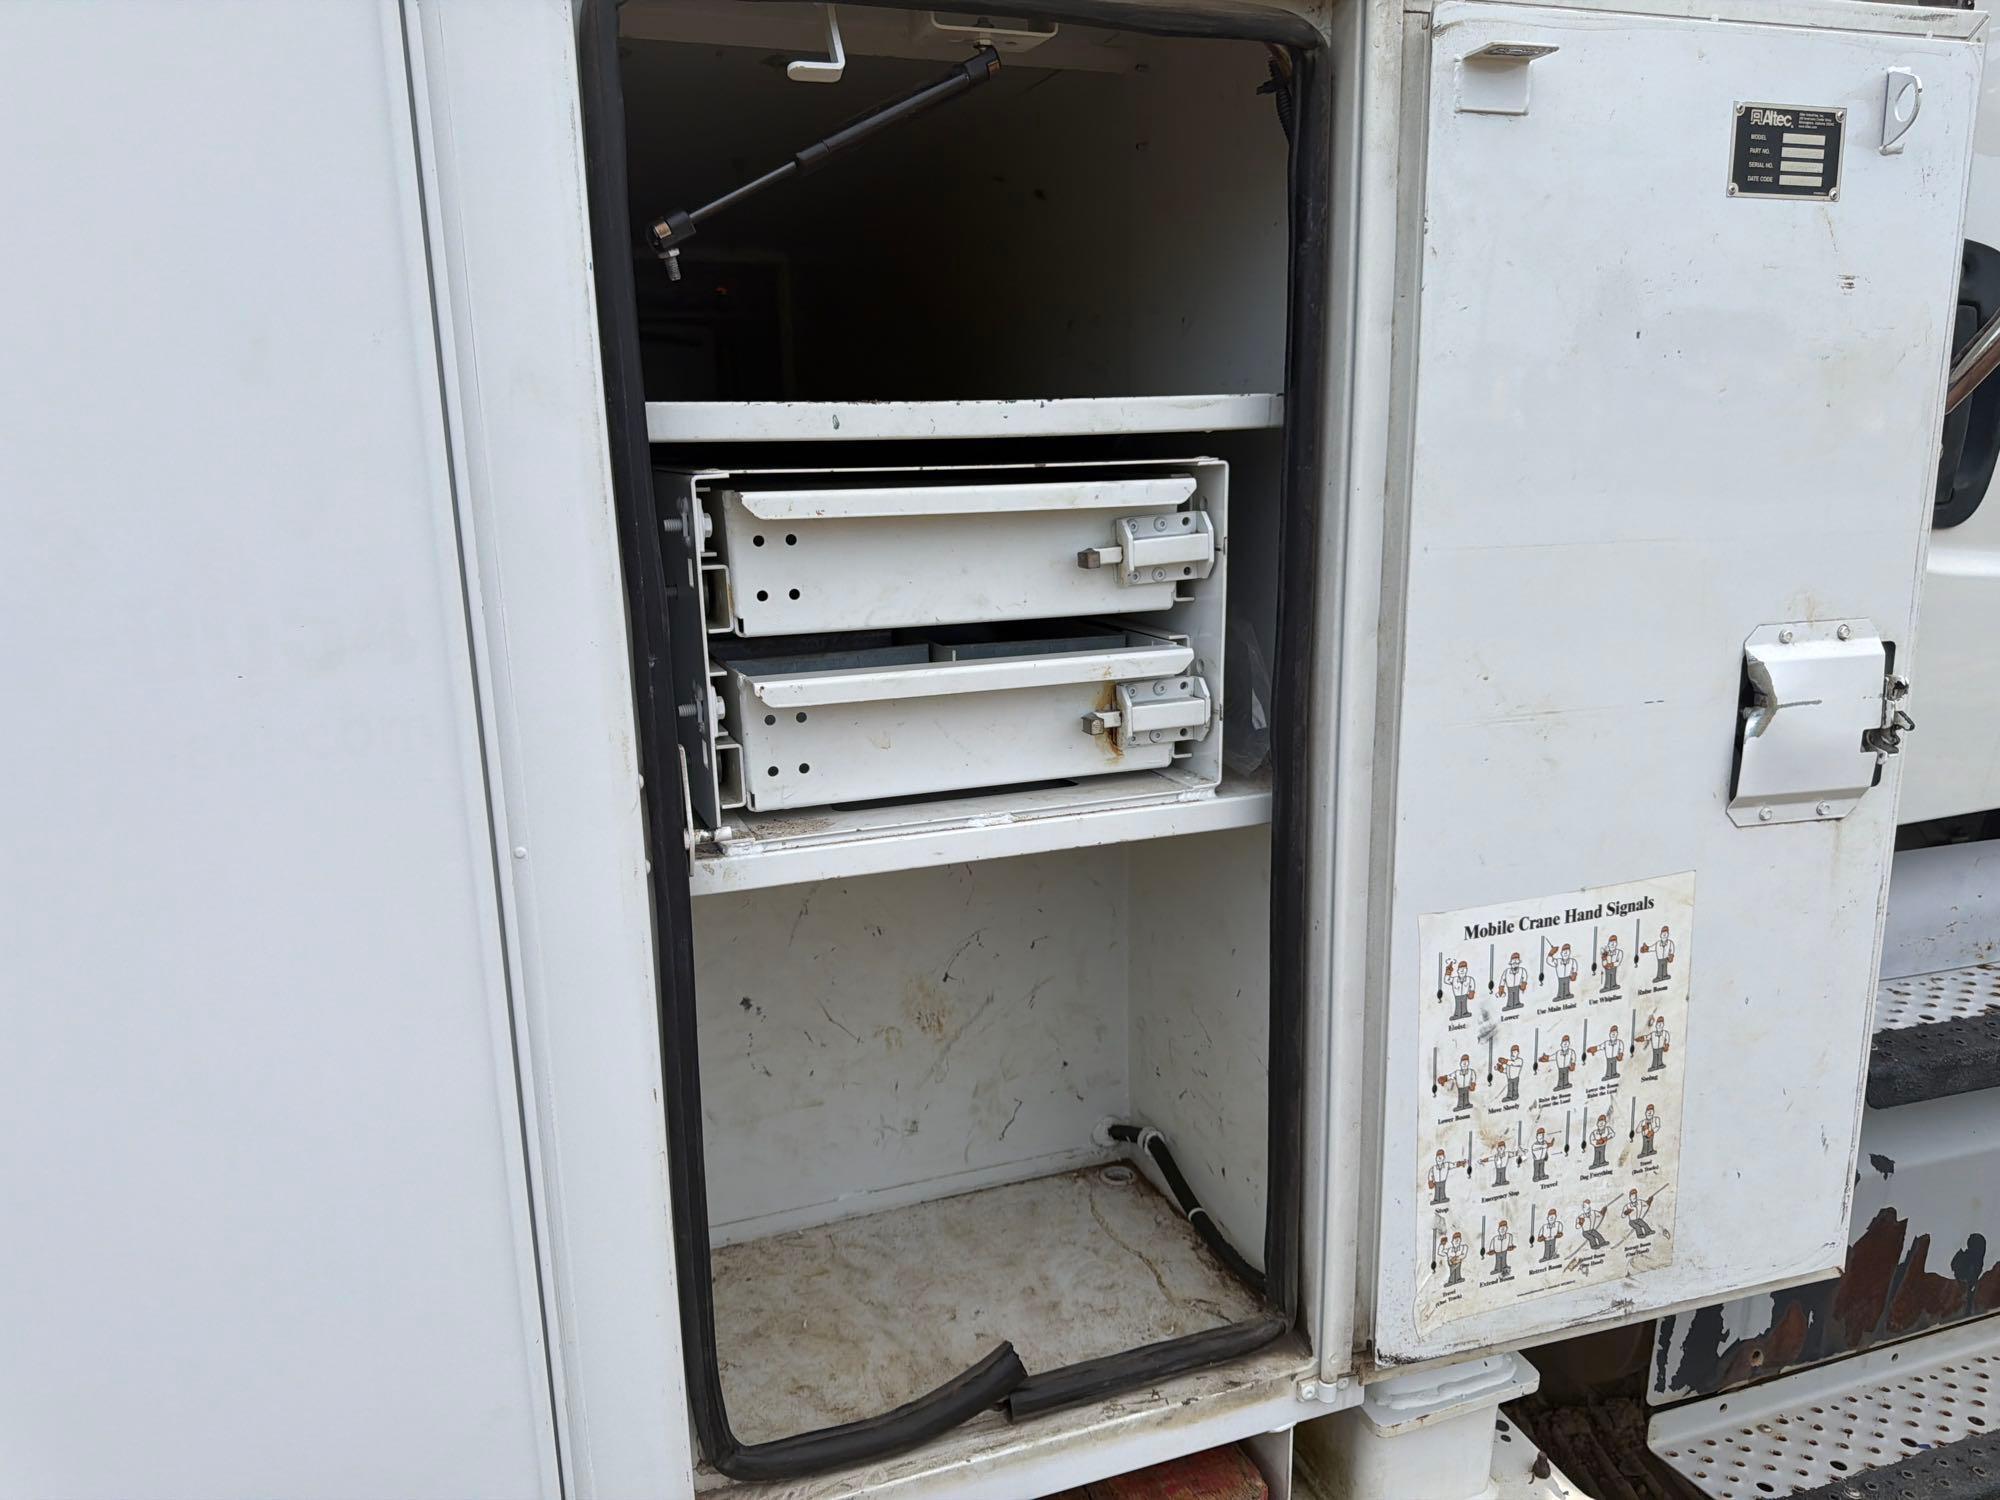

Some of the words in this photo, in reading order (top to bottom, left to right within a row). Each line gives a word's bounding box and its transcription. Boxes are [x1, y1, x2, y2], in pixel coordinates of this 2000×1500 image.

[1762, 110, 1792, 127] Altec
[1463, 920, 1514, 941] Mobile
[1518, 914, 1560, 931] Crane
[1565, 904, 1602, 924] Hand
[1606, 896, 1655, 917] Signals
[1548, 1005, 1561, 1013] Main
[1500, 1014, 1519, 1022] Lower
[1641, 1075, 1658, 1083] Swing
[1503, 1103, 1520, 1111] Slowly
[1540, 1181, 1558, 1190] Travel
[1481, 1194, 1508, 1203] Emergency
[1529, 1267, 1547, 1275] Retract
[1479, 1278, 1499, 1288] Extend
